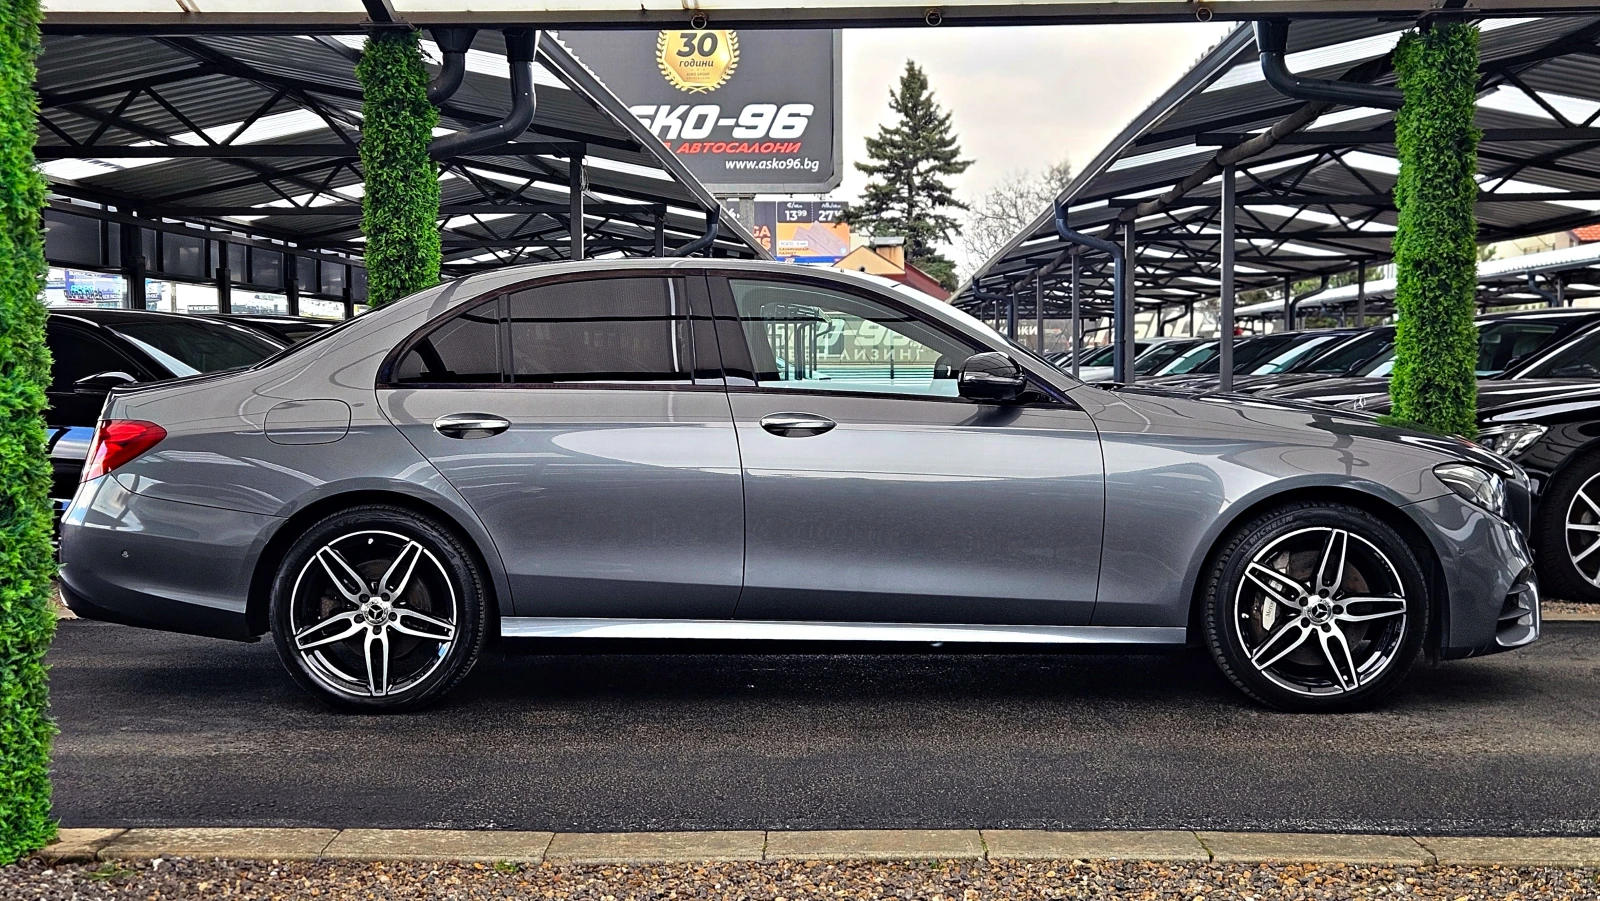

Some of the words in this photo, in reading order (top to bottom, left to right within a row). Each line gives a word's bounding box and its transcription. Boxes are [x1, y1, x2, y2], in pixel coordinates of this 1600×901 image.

[676, 32, 718, 57] 30
[679, 58, 714, 68] години
[628, 104, 814, 139] SKO-96
[676, 142, 802, 154] АВТОСАЛОНИ
[725, 157, 819, 172] www.asko96.bg
[840, 348, 924, 360] ЛИЗИНГ
[1249, 515, 1293, 545] MICHELIN
